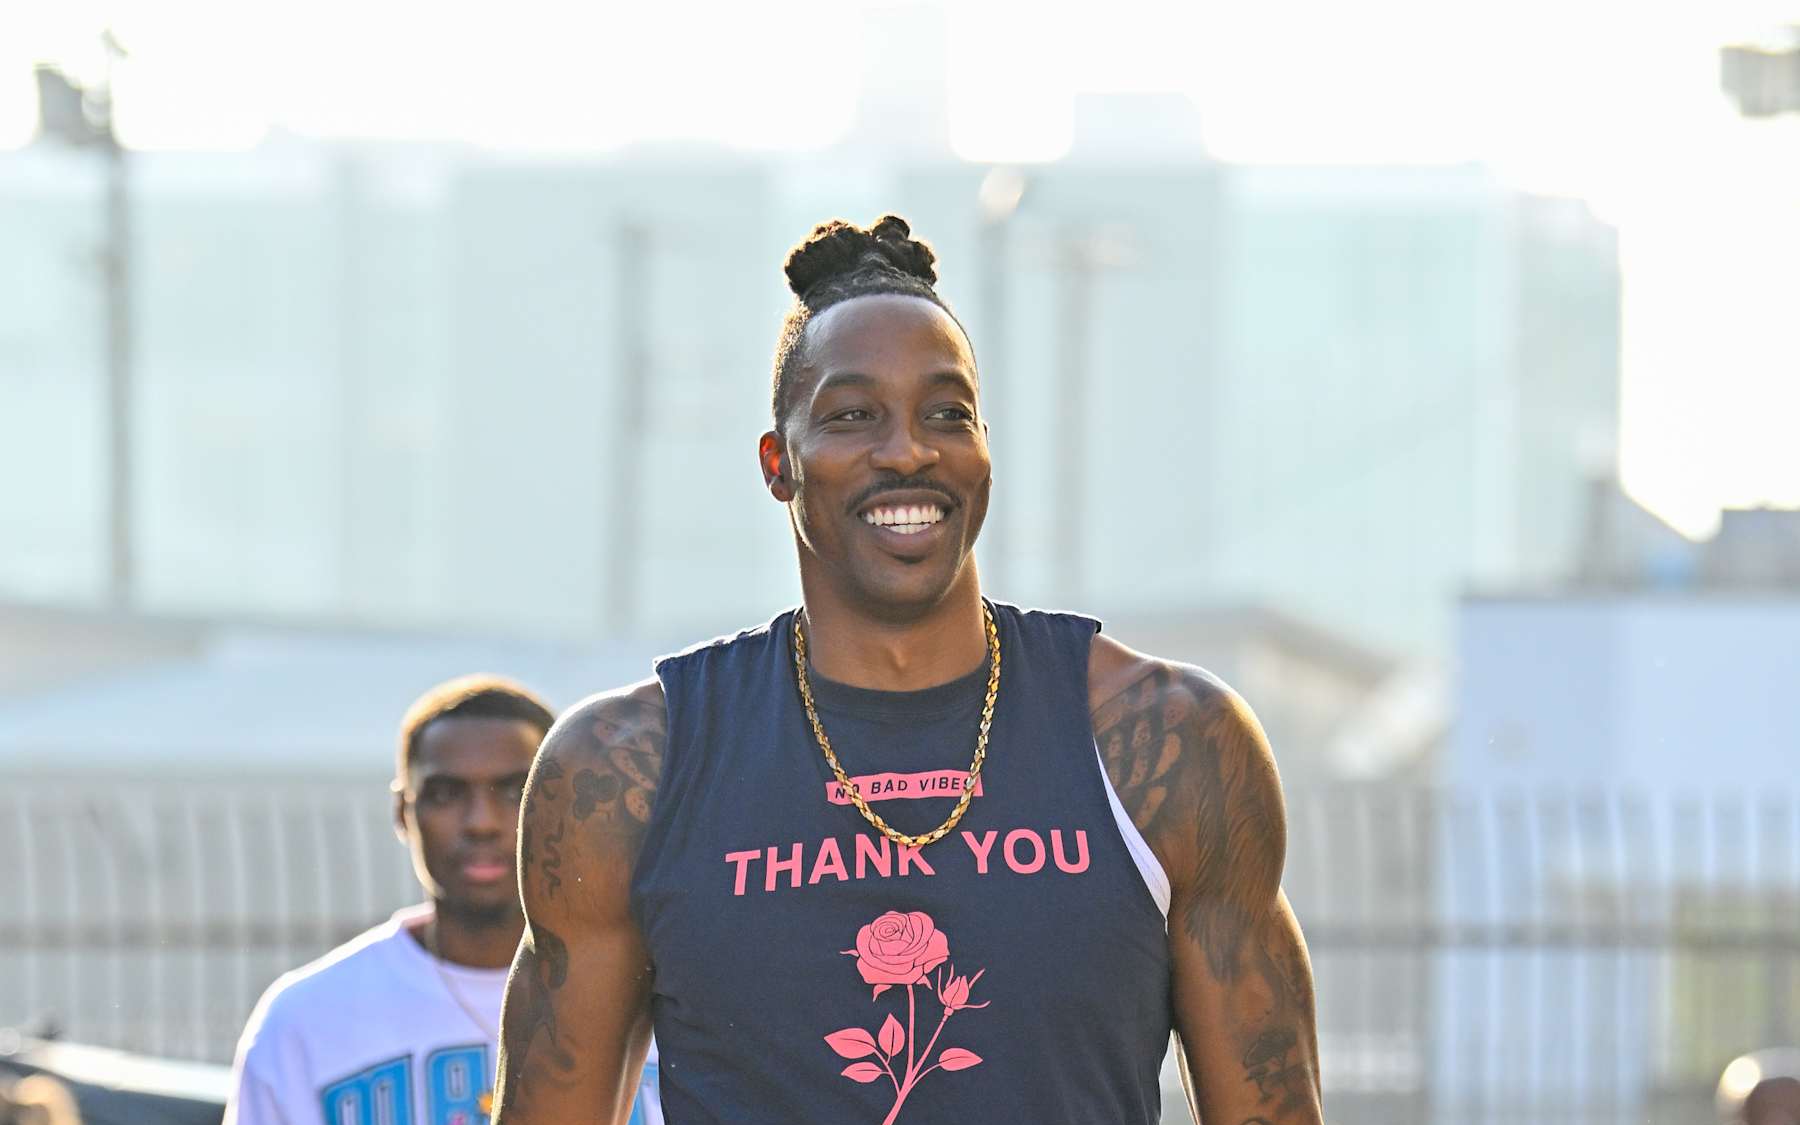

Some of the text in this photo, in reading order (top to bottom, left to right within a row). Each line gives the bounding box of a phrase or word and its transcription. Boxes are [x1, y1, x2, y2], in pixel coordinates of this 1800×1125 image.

[871, 779, 908, 795] BAD
[725, 828, 1091, 896] THANK YOU
